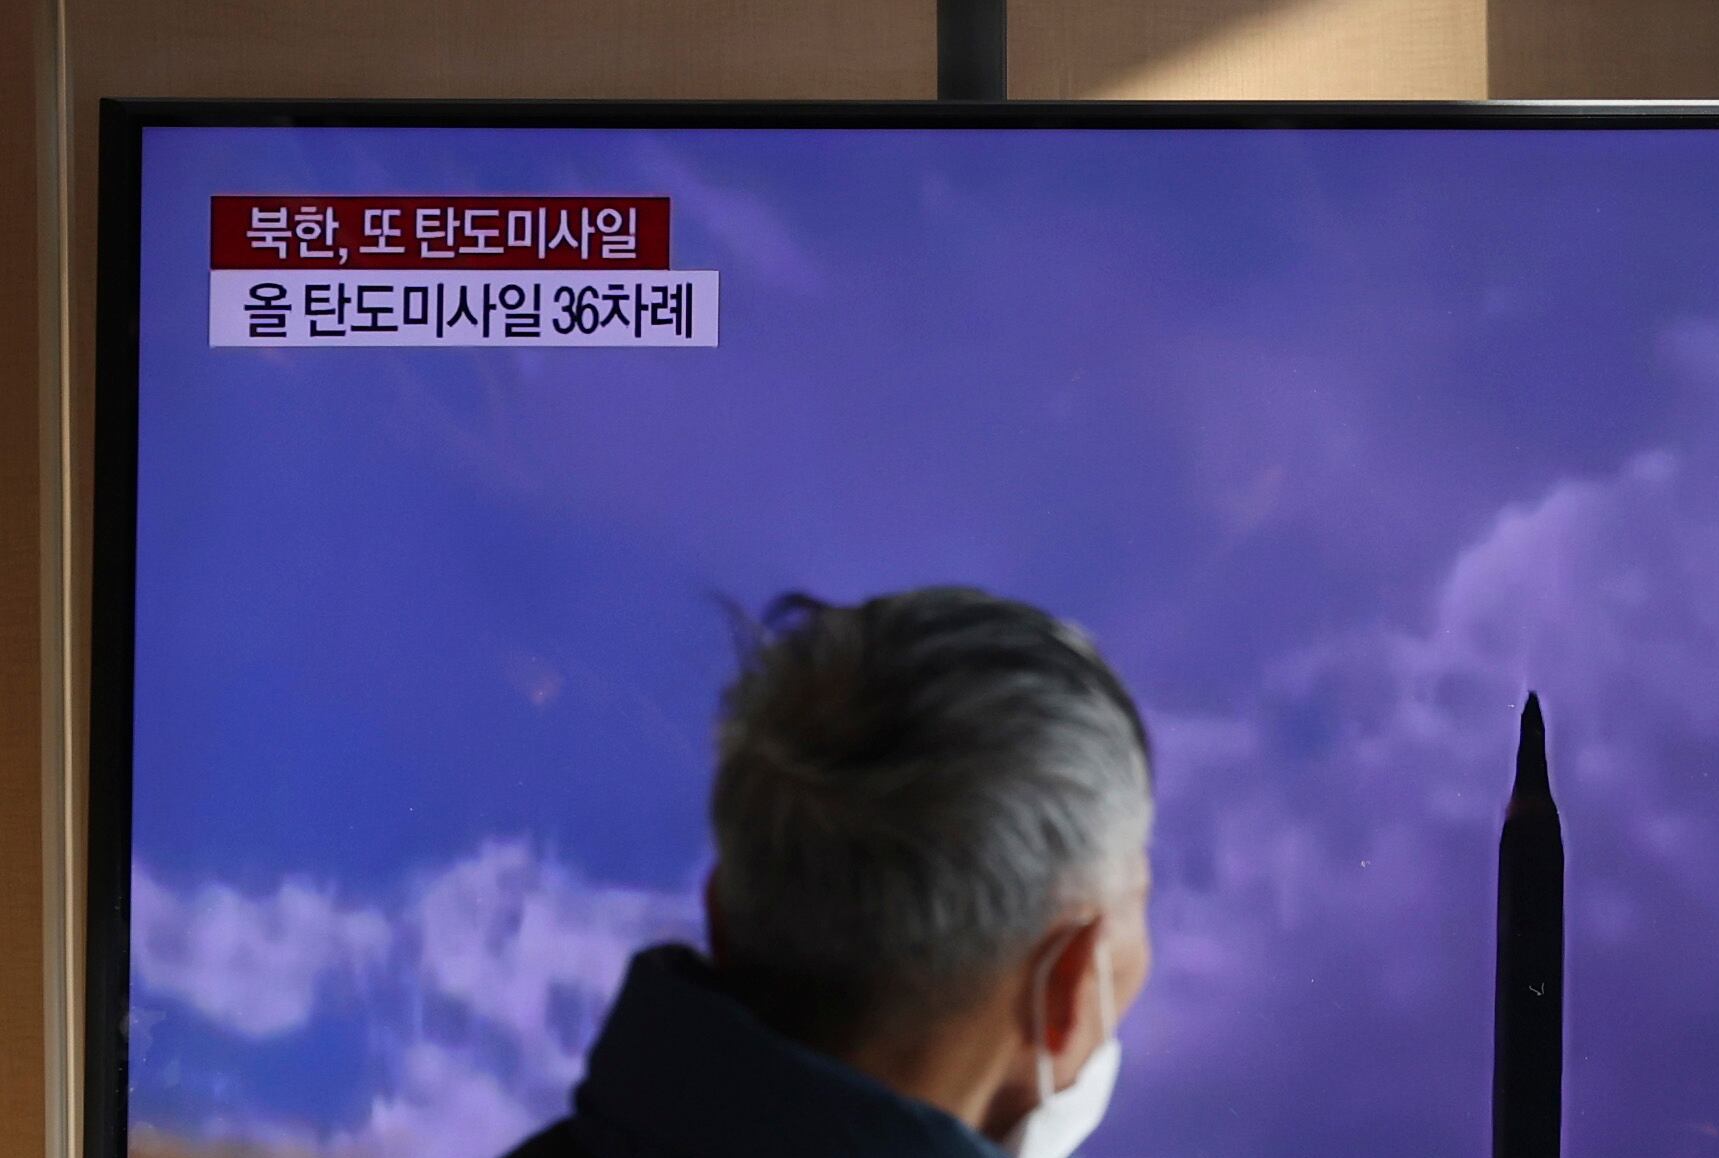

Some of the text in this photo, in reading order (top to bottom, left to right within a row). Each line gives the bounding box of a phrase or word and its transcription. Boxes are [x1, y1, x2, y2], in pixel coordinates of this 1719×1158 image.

[246, 205, 637, 265] 북한, 또 탄도미사일
[244, 281, 693, 339] 올 탄도미사일 36차례
